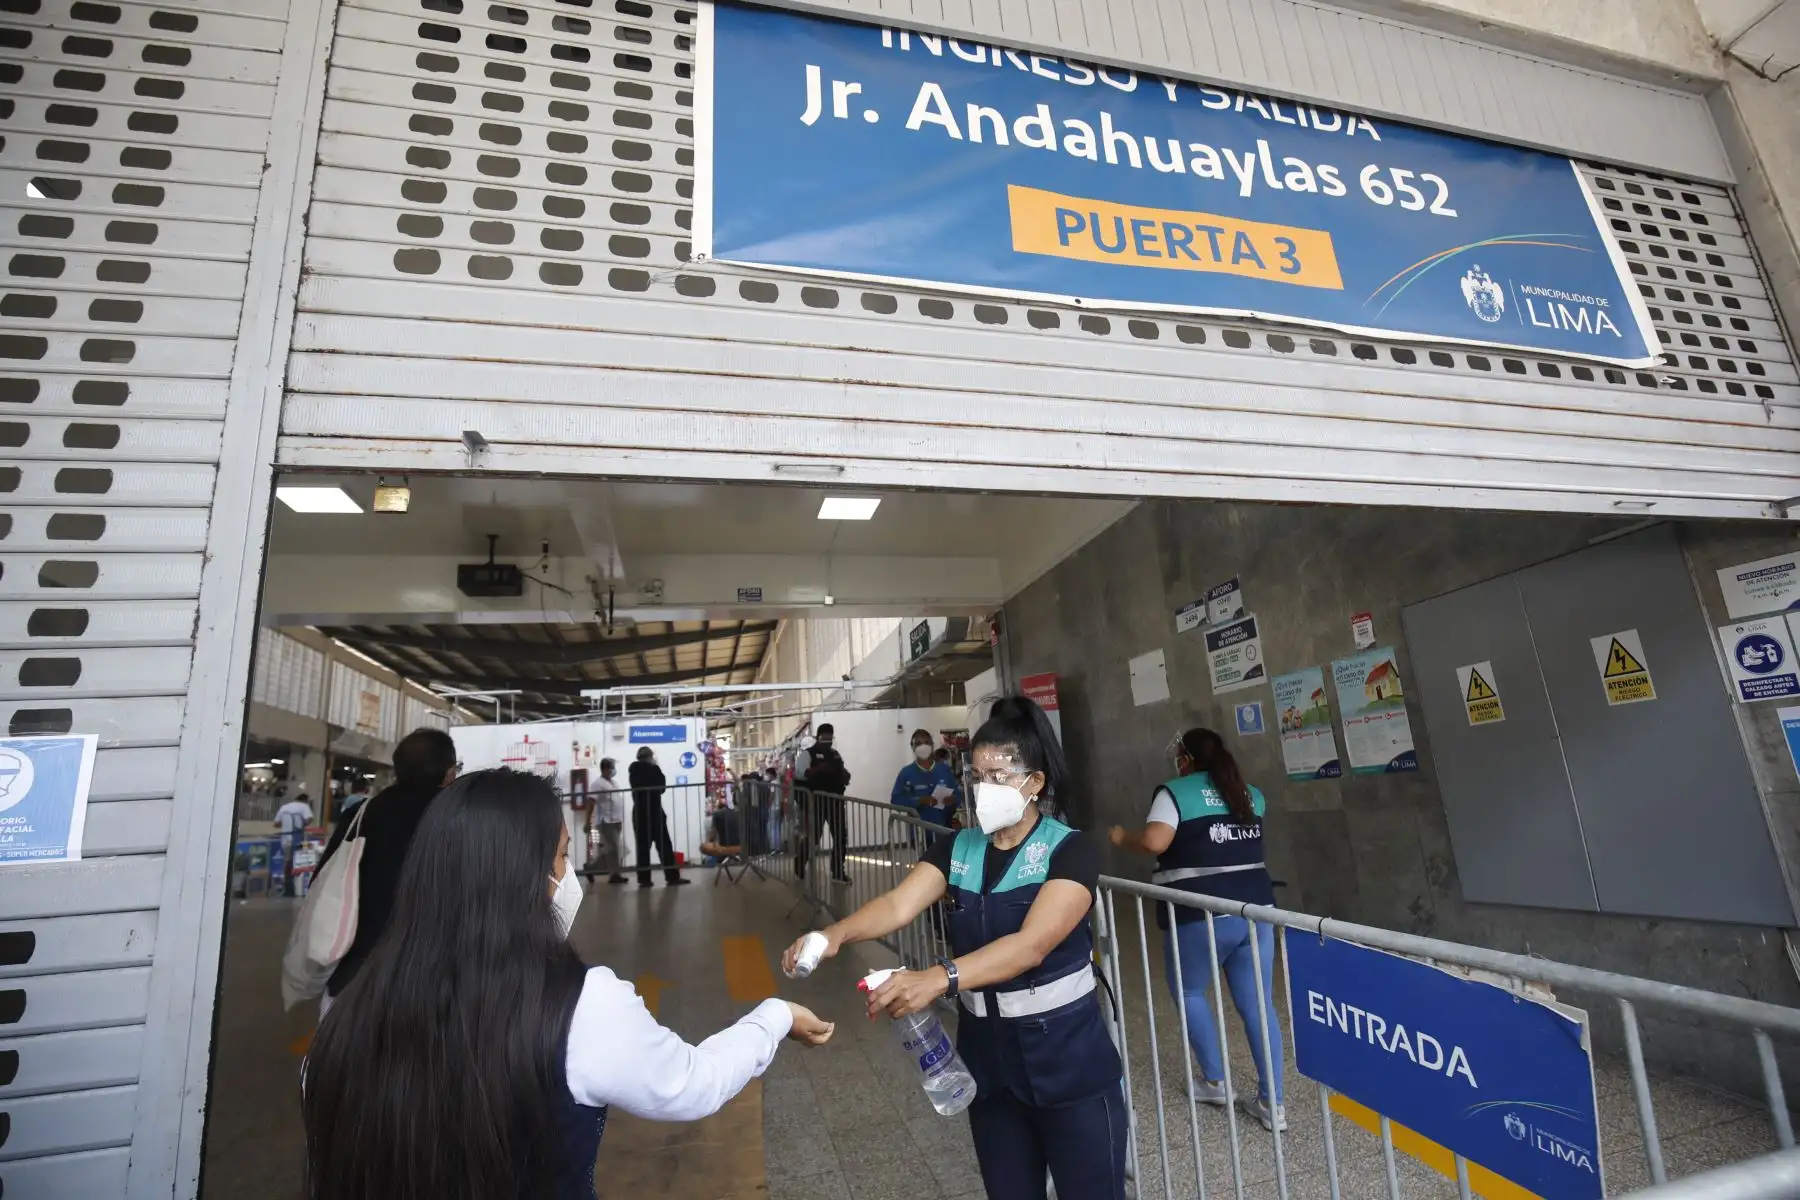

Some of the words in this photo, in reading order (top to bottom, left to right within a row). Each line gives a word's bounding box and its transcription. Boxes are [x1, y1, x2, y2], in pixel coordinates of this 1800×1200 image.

[800, 64, 879, 126] Jr.
[905, 81, 1347, 197] Andahuaylas
[1359, 164, 1458, 217] 652
[1055, 207, 1266, 270] PUERTA
[1273, 236, 1303, 275] 3
[1520, 284, 1595, 306] MUNICIPALIDAD
[1596, 298, 1611, 308] DE
[1526, 298, 1623, 338] LIMA
[1608, 675, 1649, 691] ATENCIÓN
[1763, 688, 1789, 696] ENTRAR
[1469, 701, 1499, 713] ATENCIÓN
[1308, 989, 1478, 1088] ENTRADA
[1537, 1134, 1594, 1174] LIMA
